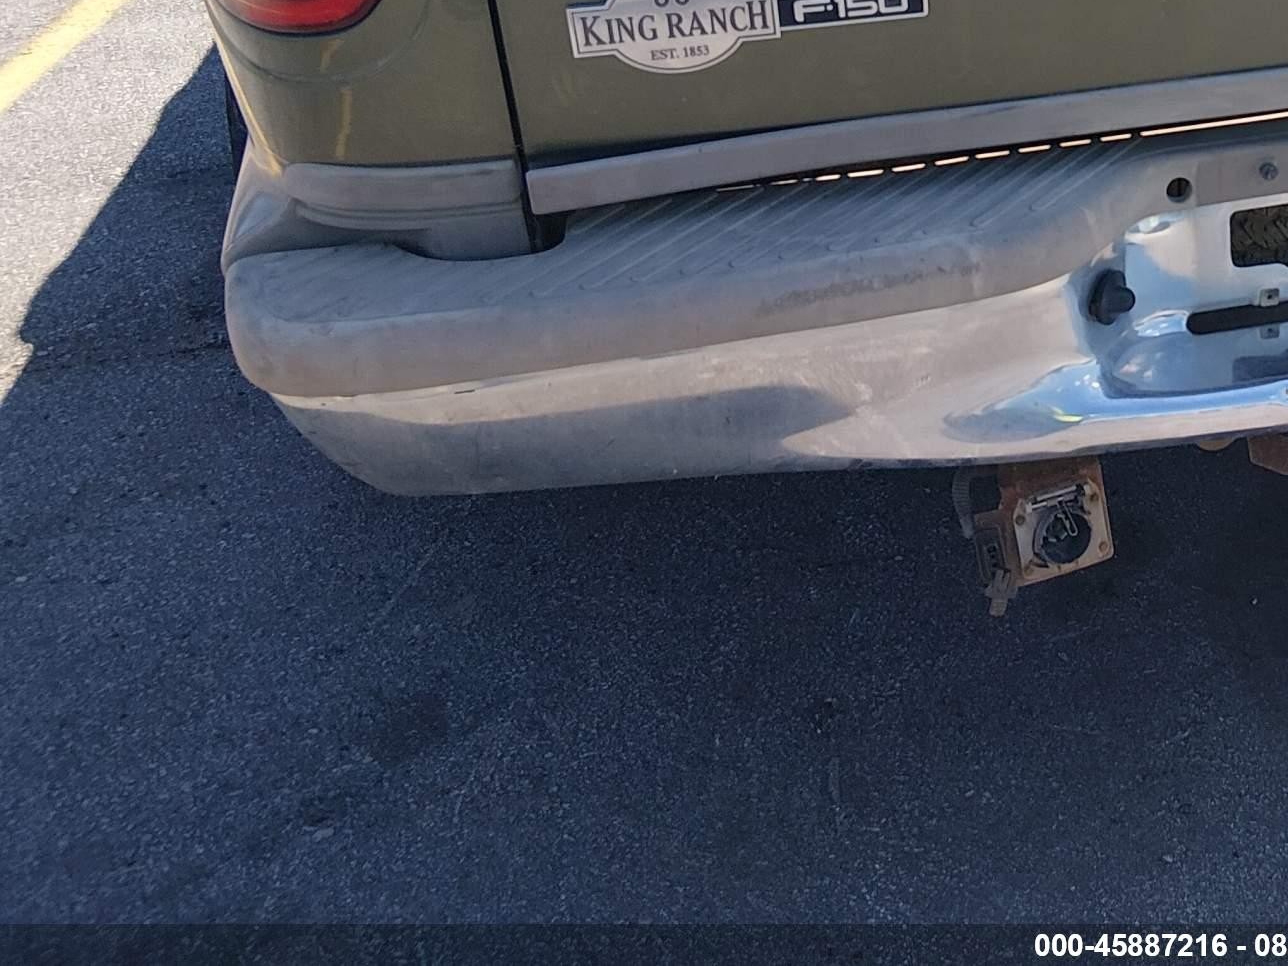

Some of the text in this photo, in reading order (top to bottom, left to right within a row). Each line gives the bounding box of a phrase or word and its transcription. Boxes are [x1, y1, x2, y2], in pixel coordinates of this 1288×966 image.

[580, 0, 769, 46] KING RANCH
[650, 44, 710, 61] EST. 1853
